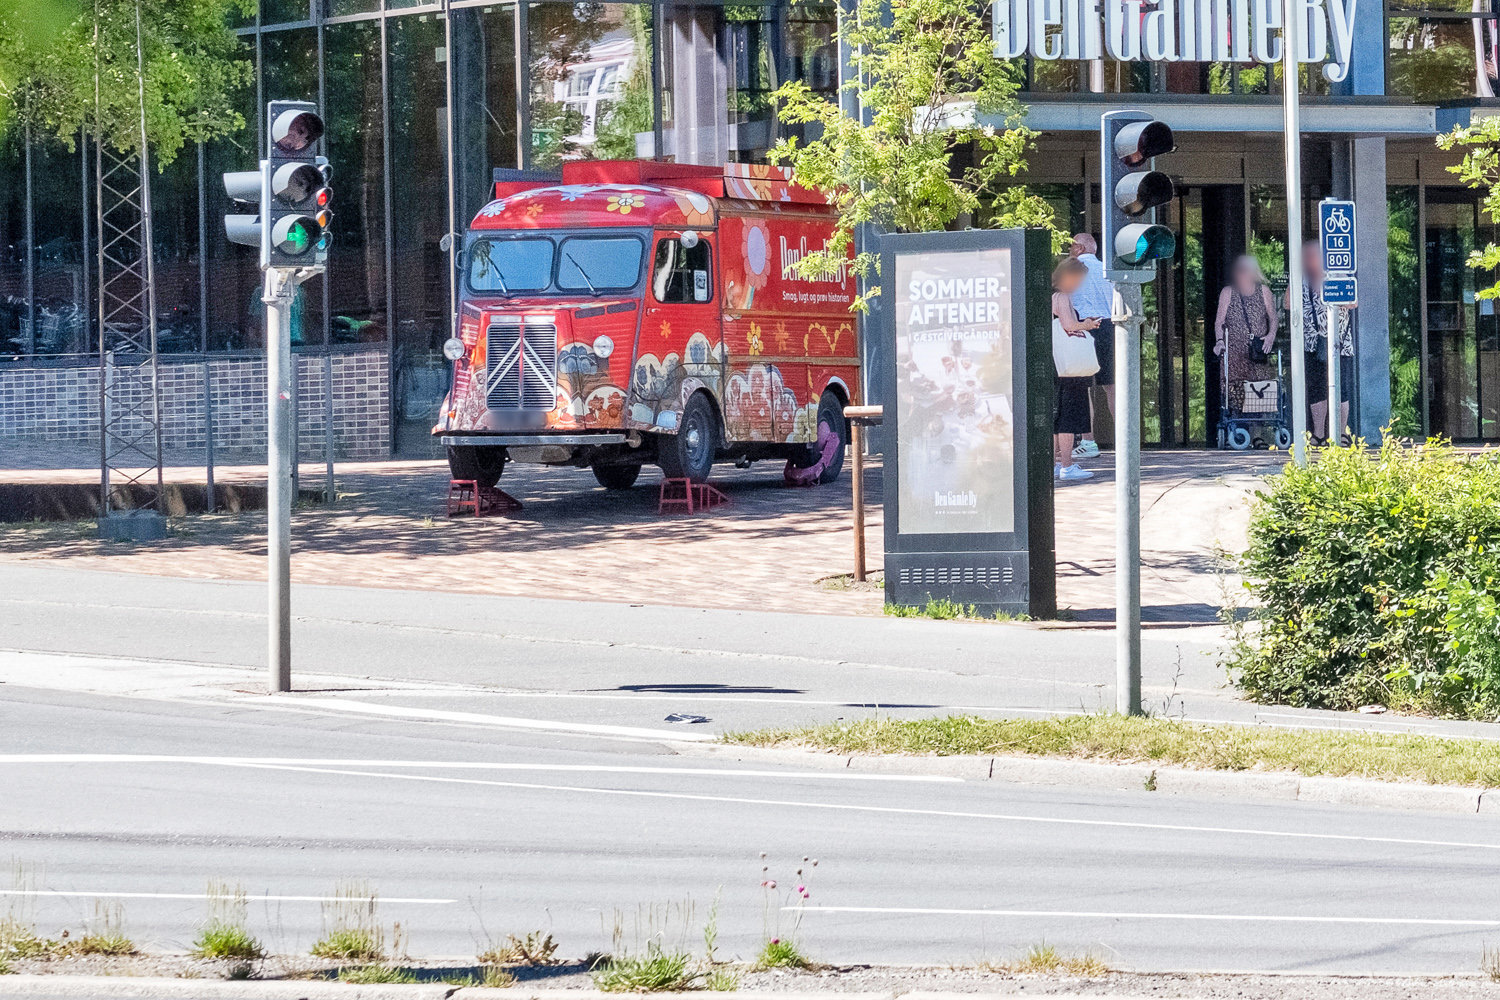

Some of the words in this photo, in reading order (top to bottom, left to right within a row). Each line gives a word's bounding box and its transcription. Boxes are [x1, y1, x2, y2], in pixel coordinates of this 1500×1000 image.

[1333, 237, 1344, 248] 16
[1329, 254, 1349, 266] 809
[909, 277, 1008, 301] SOMMER-
[782, 290, 798, 303] Smag,
[799, 291, 809, 304] lugt
[809, 294, 817, 304] og
[817, 293, 828, 304] prøv
[828, 292, 850, 303] historien
[908, 301, 1000, 325] AFTENER
[908, 333, 912, 342] I
[913, 328, 1001, 343] GÆSTGIVERGÅRDEN
[935, 490, 947, 507] Den
[948, 490, 968, 506] Gamle
